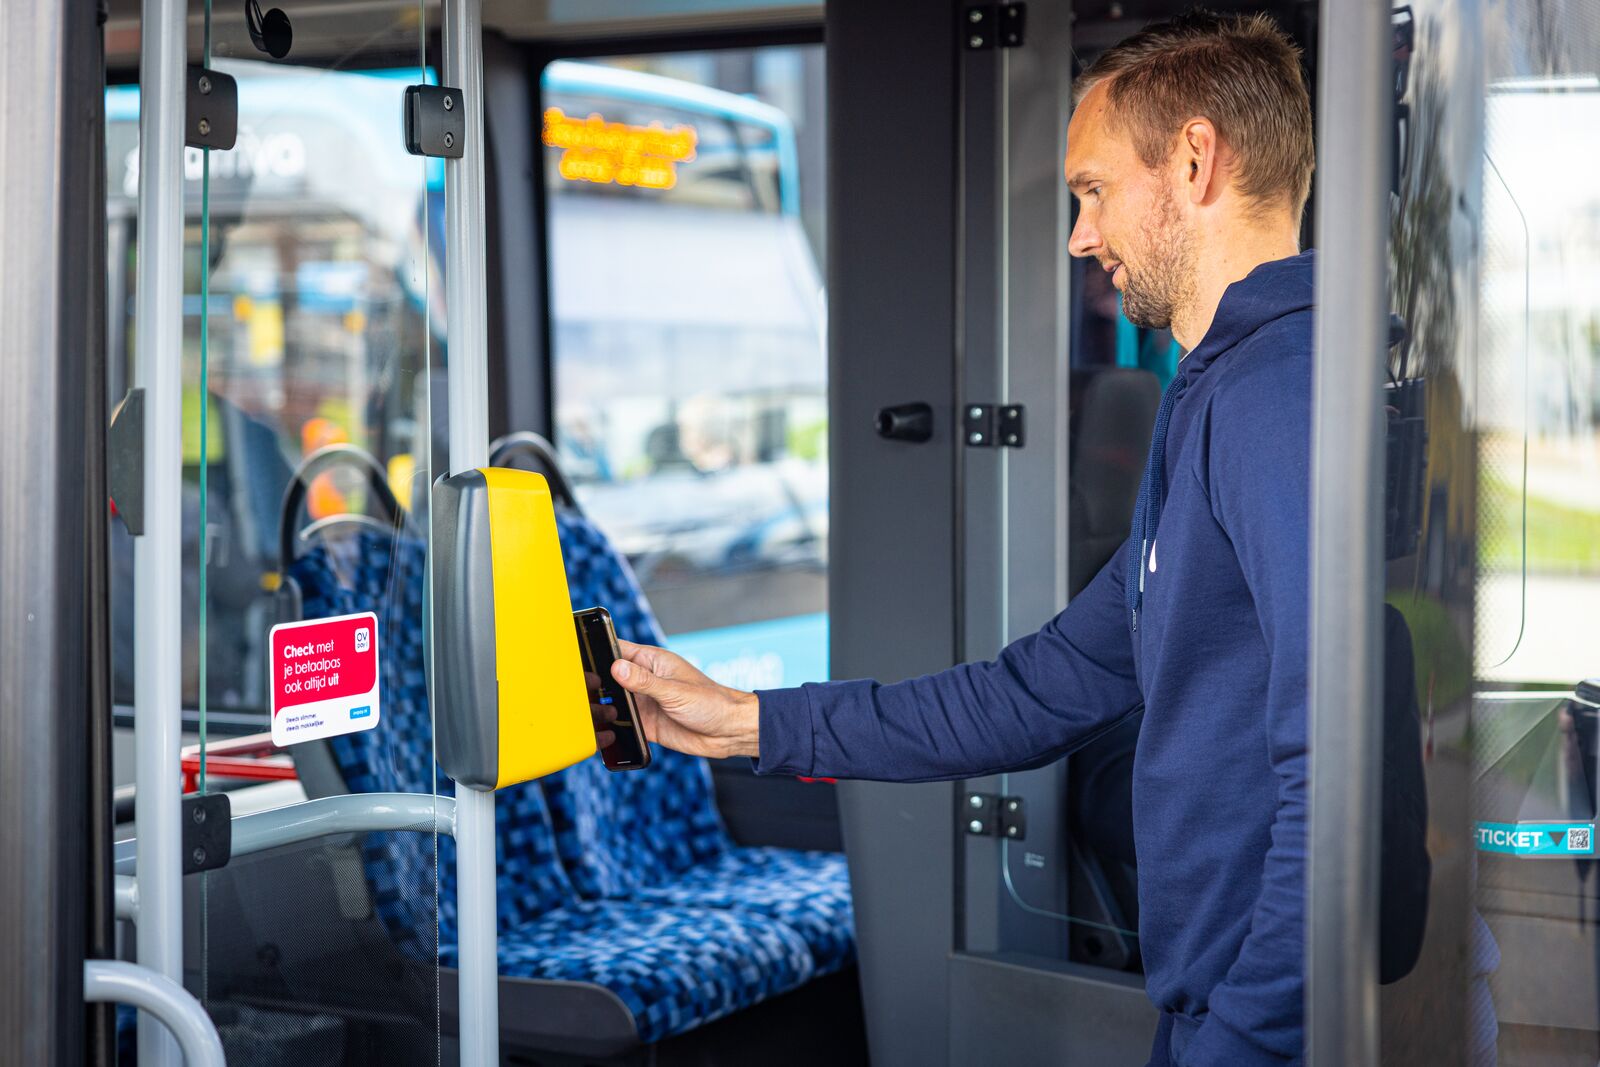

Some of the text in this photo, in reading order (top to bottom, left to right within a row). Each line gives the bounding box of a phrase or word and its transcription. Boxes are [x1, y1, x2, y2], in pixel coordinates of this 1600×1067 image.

[357, 632, 367, 641] OV
[284, 640, 334, 659] Check met
[284, 658, 341, 680] je betaalpas
[285, 673, 339, 694] ook altijd uit
